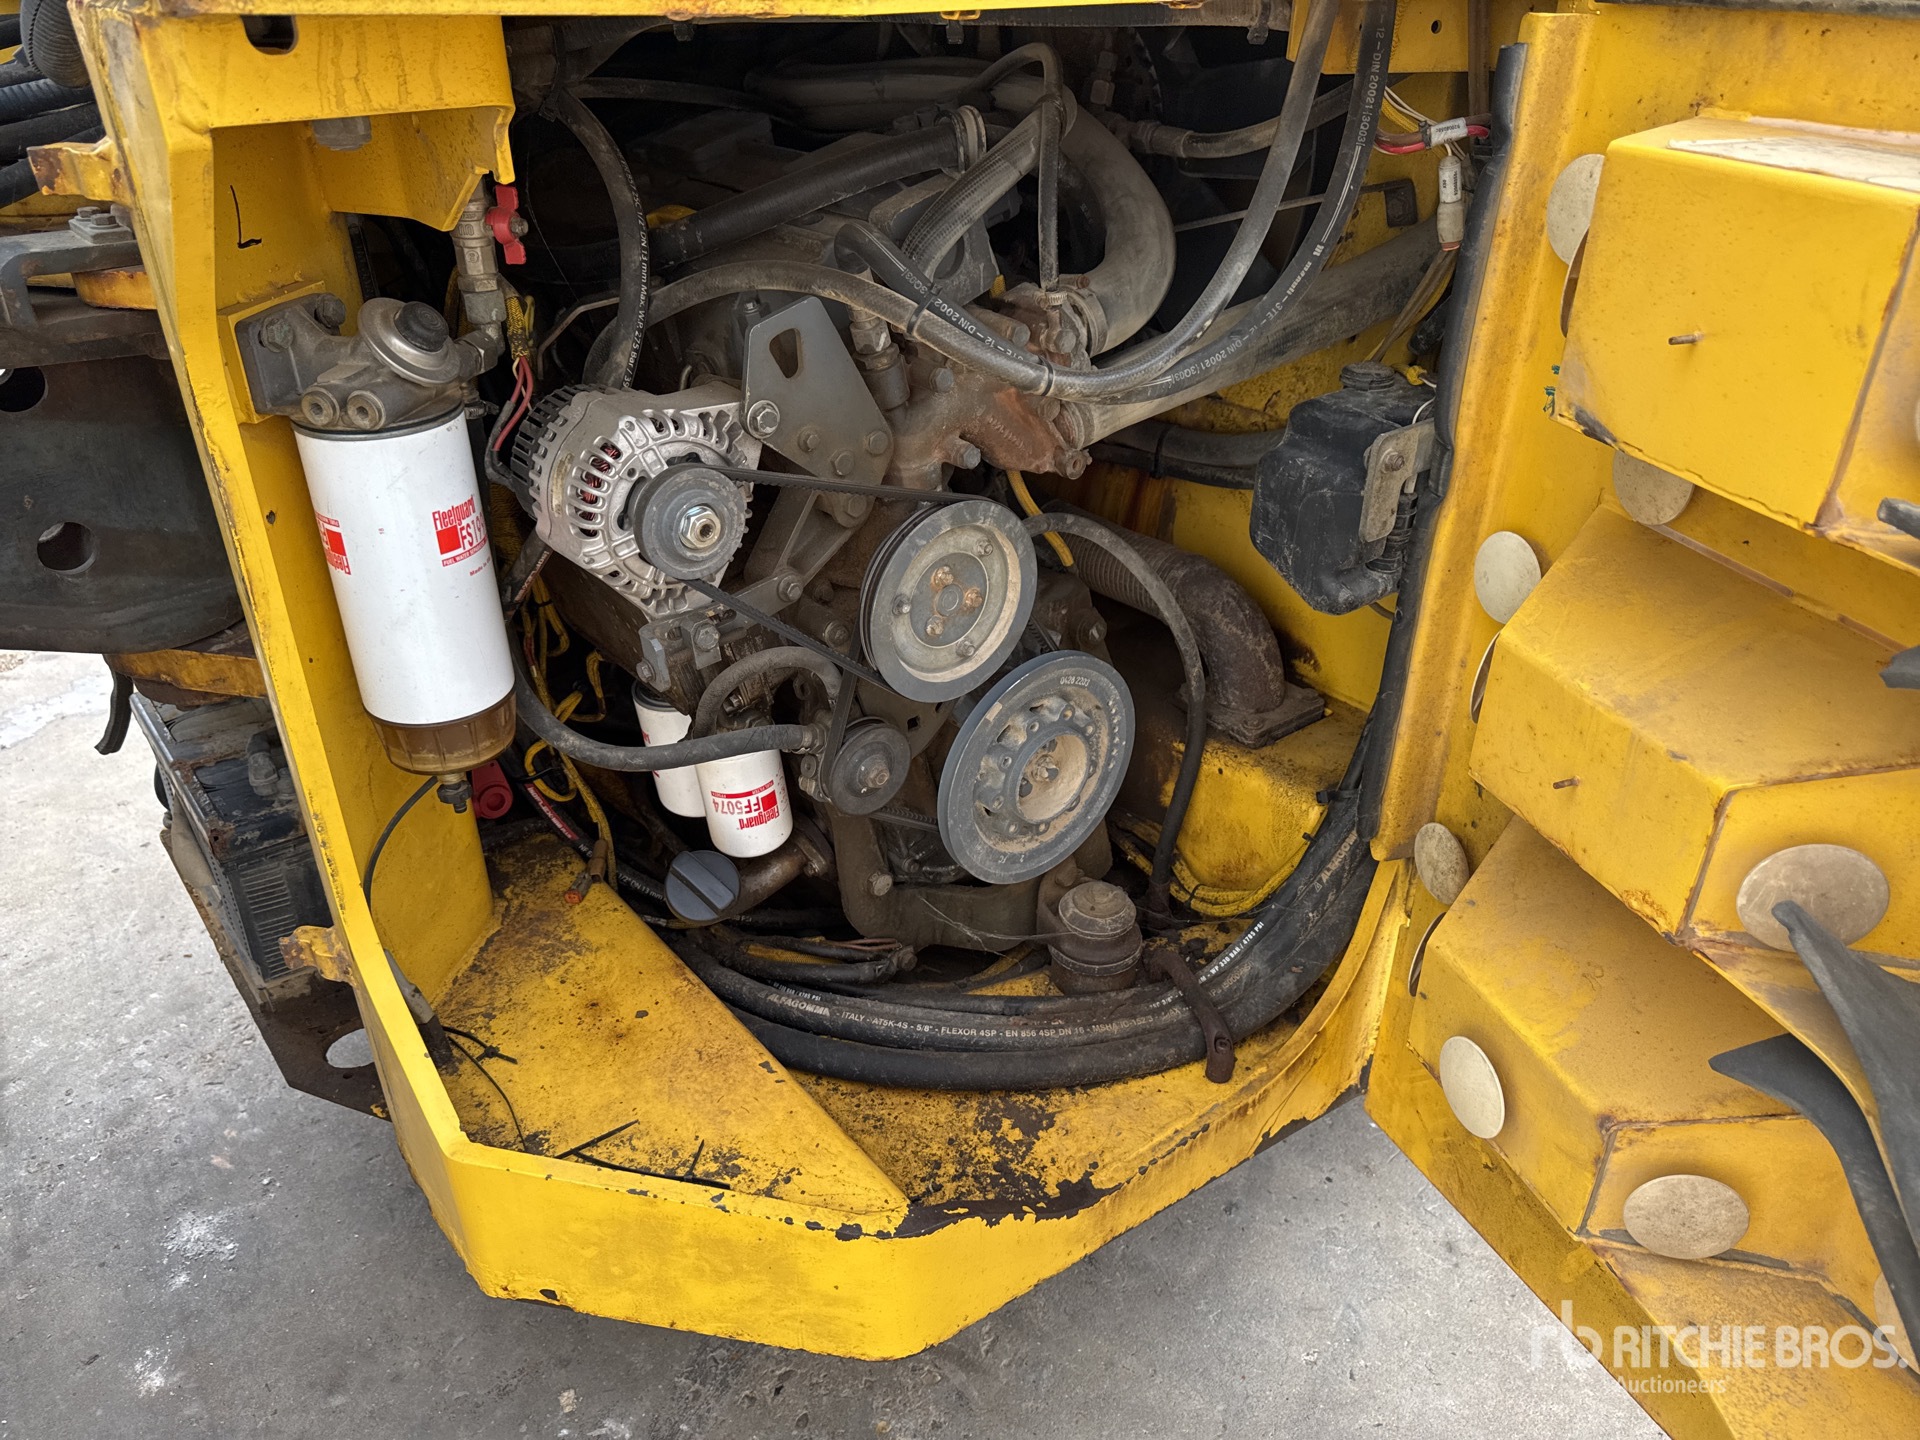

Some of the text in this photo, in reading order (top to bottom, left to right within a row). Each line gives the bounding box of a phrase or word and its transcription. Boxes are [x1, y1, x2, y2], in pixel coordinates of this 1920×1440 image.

[1372, 52, 1382, 73] DIN
[959, 319, 977, 335] DIN
[632, 330, 642, 350] 275
[1227, 337, 1243, 354] DIN
[628, 350, 638, 368] Bar
[432, 495, 476, 531] Fleetguard
[712, 796, 762, 816] FF5074
[738, 804, 780, 830] Fleetguard
[1254, 921, 1265, 932] PSI
[766, 992, 830, 1017] ALFAGOMMA
[841, 1011, 866, 1022] ITALY
[940, 1026, 977, 1036] FLEXOR
[979, 1028, 997, 1037] 4SP
[1005, 1030, 1018, 1038] EN
[1038, 1028, 1056, 1037] 4SP
[1058, 1028, 1072, 1037] DN
